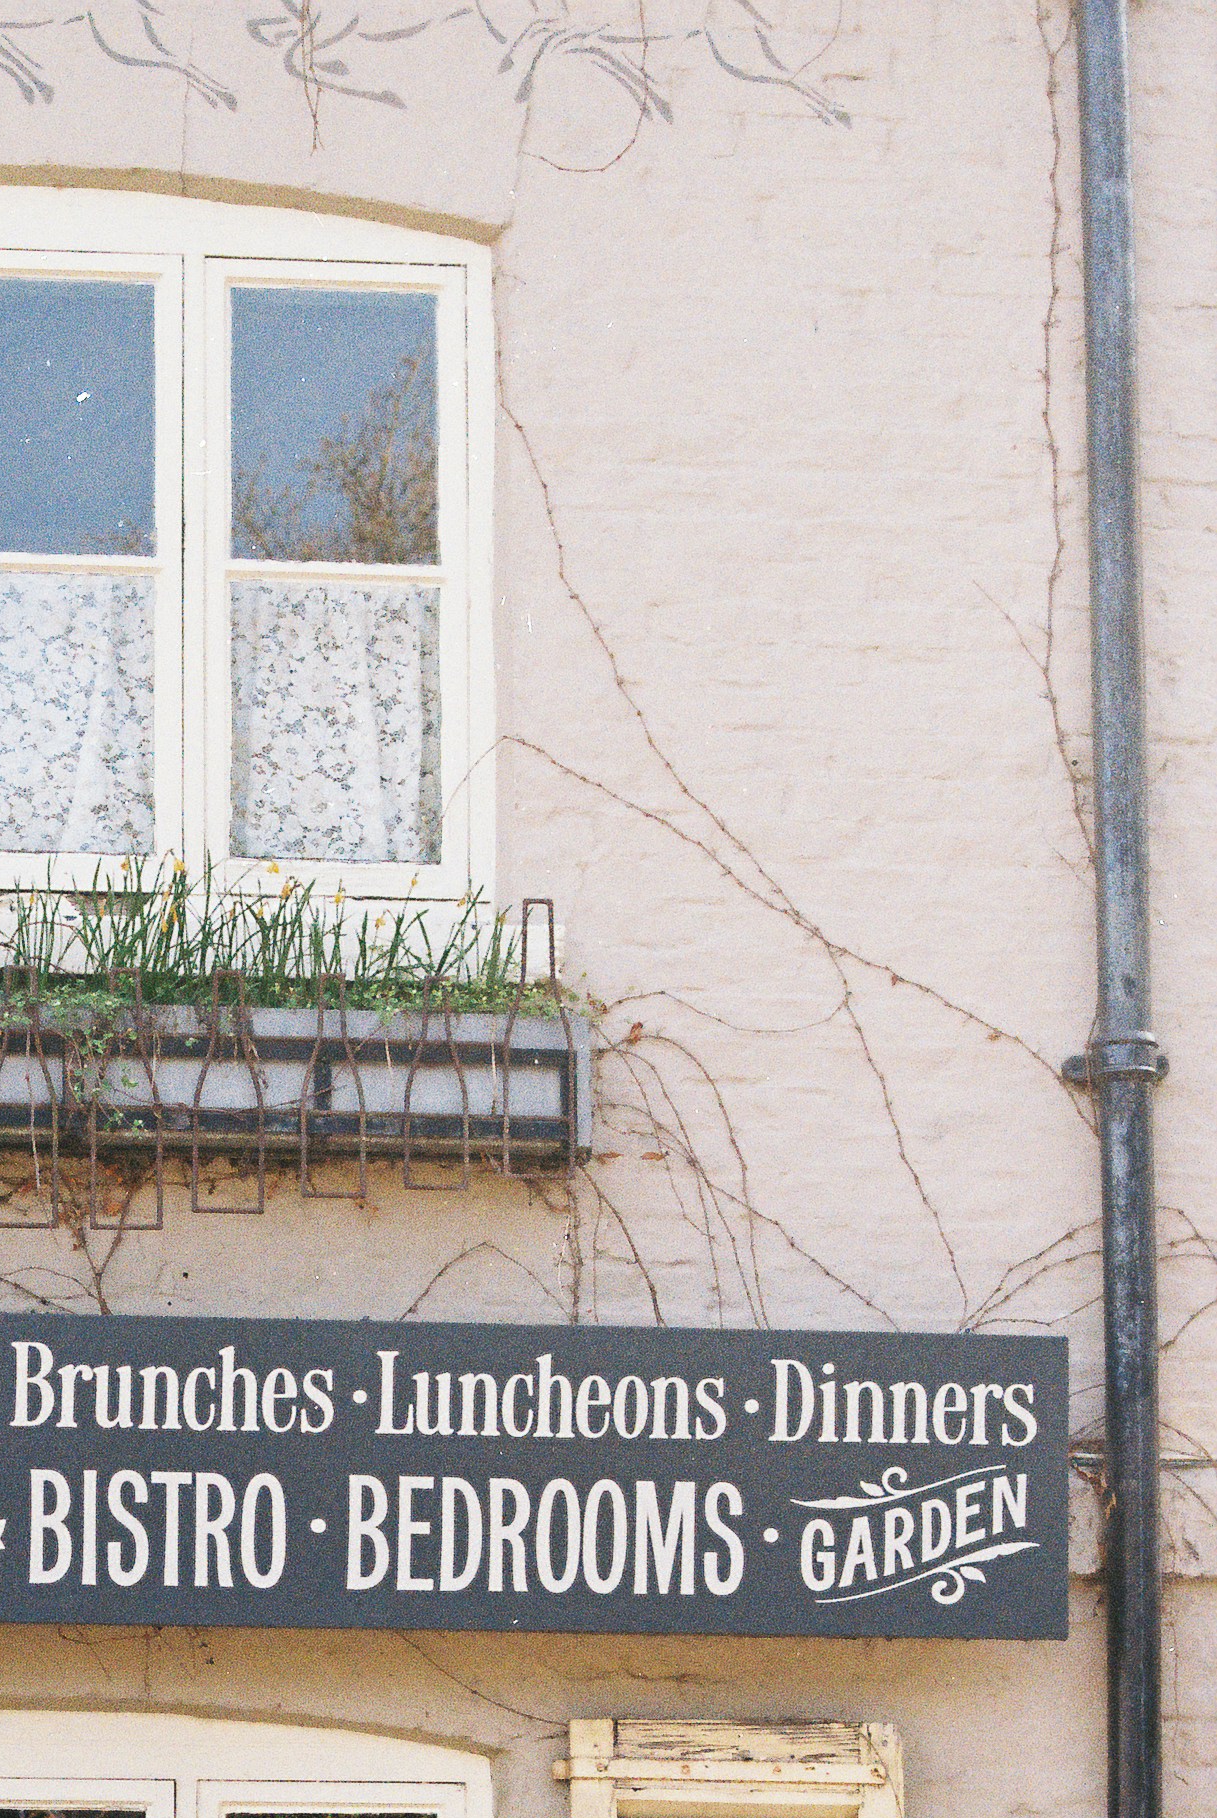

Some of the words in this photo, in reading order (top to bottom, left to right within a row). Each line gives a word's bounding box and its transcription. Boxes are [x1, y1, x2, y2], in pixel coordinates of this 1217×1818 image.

[10, 1341, 336, 1434] Brunches
[375, 1350, 728, 1440] Luncheons
[769, 1359, 1039, 1447] Dinners
[29, 1469, 286, 1589] BISTRO
[347, 1474, 745, 1596] BEDROOMS
[800, 1473, 1029, 1592] GARDEN
